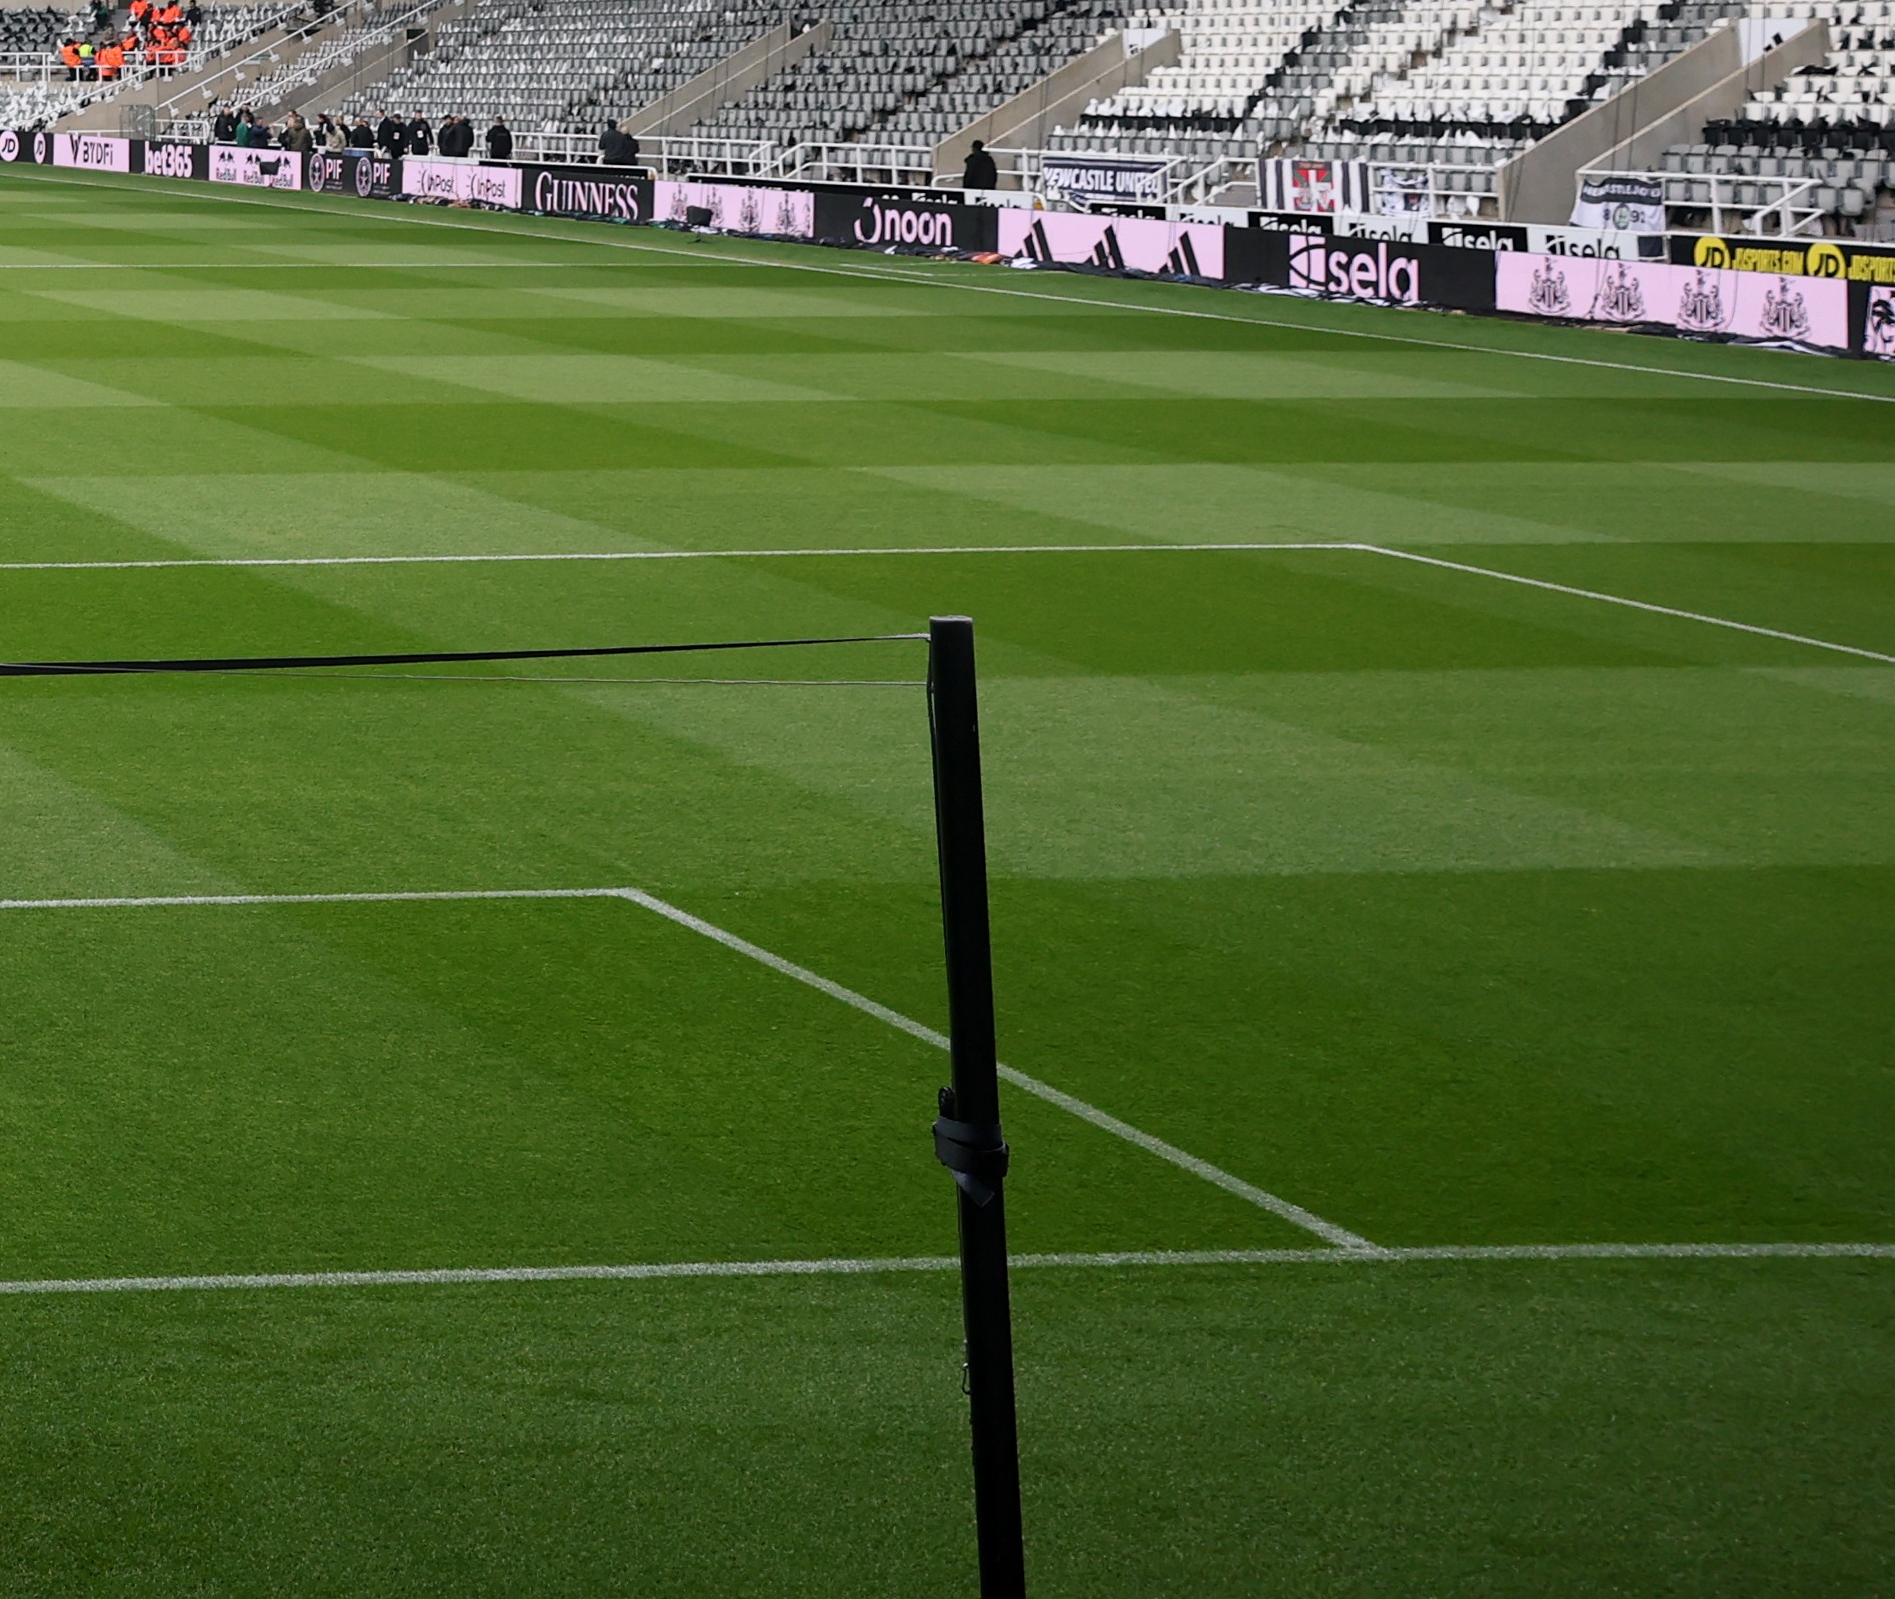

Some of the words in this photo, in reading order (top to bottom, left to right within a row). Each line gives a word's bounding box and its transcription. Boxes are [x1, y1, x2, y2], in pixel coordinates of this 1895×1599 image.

[2, 139, 15, 153] JD
[83, 140, 113, 165] BYDFi
[144, 139, 193, 177] bet365
[325, 158, 343, 179] PIF
[373, 162, 390, 184] PIF
[1043, 167, 1112, 191] NEWCASTLE
[476, 174, 506, 199] InPost
[535, 171, 638, 220] GUINNESS
[884, 209, 952, 247] noon
[1328, 242, 1420, 302] sela
